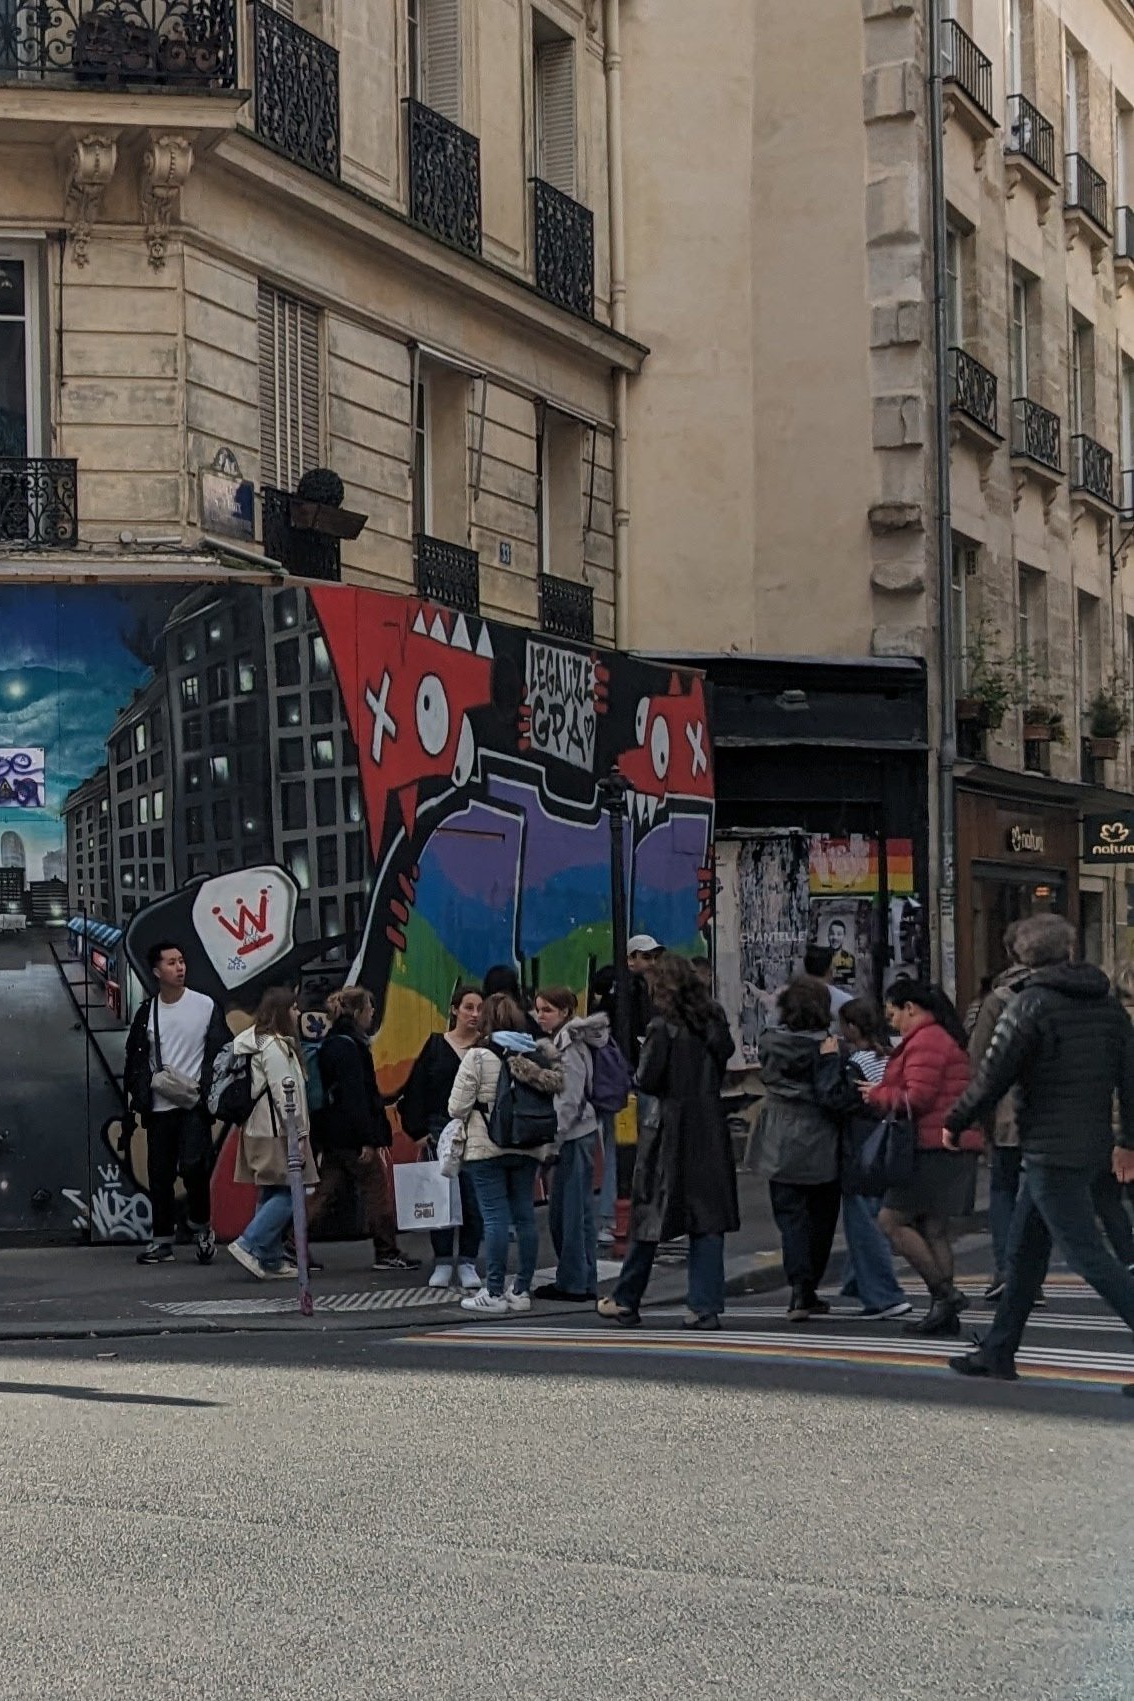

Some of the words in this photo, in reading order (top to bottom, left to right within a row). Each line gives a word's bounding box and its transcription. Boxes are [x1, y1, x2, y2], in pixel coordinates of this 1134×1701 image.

[529, 644, 595, 707] LEGALIZE
[532, 694, 587, 763] GPA
[1092, 843, 1134, 855] natura
